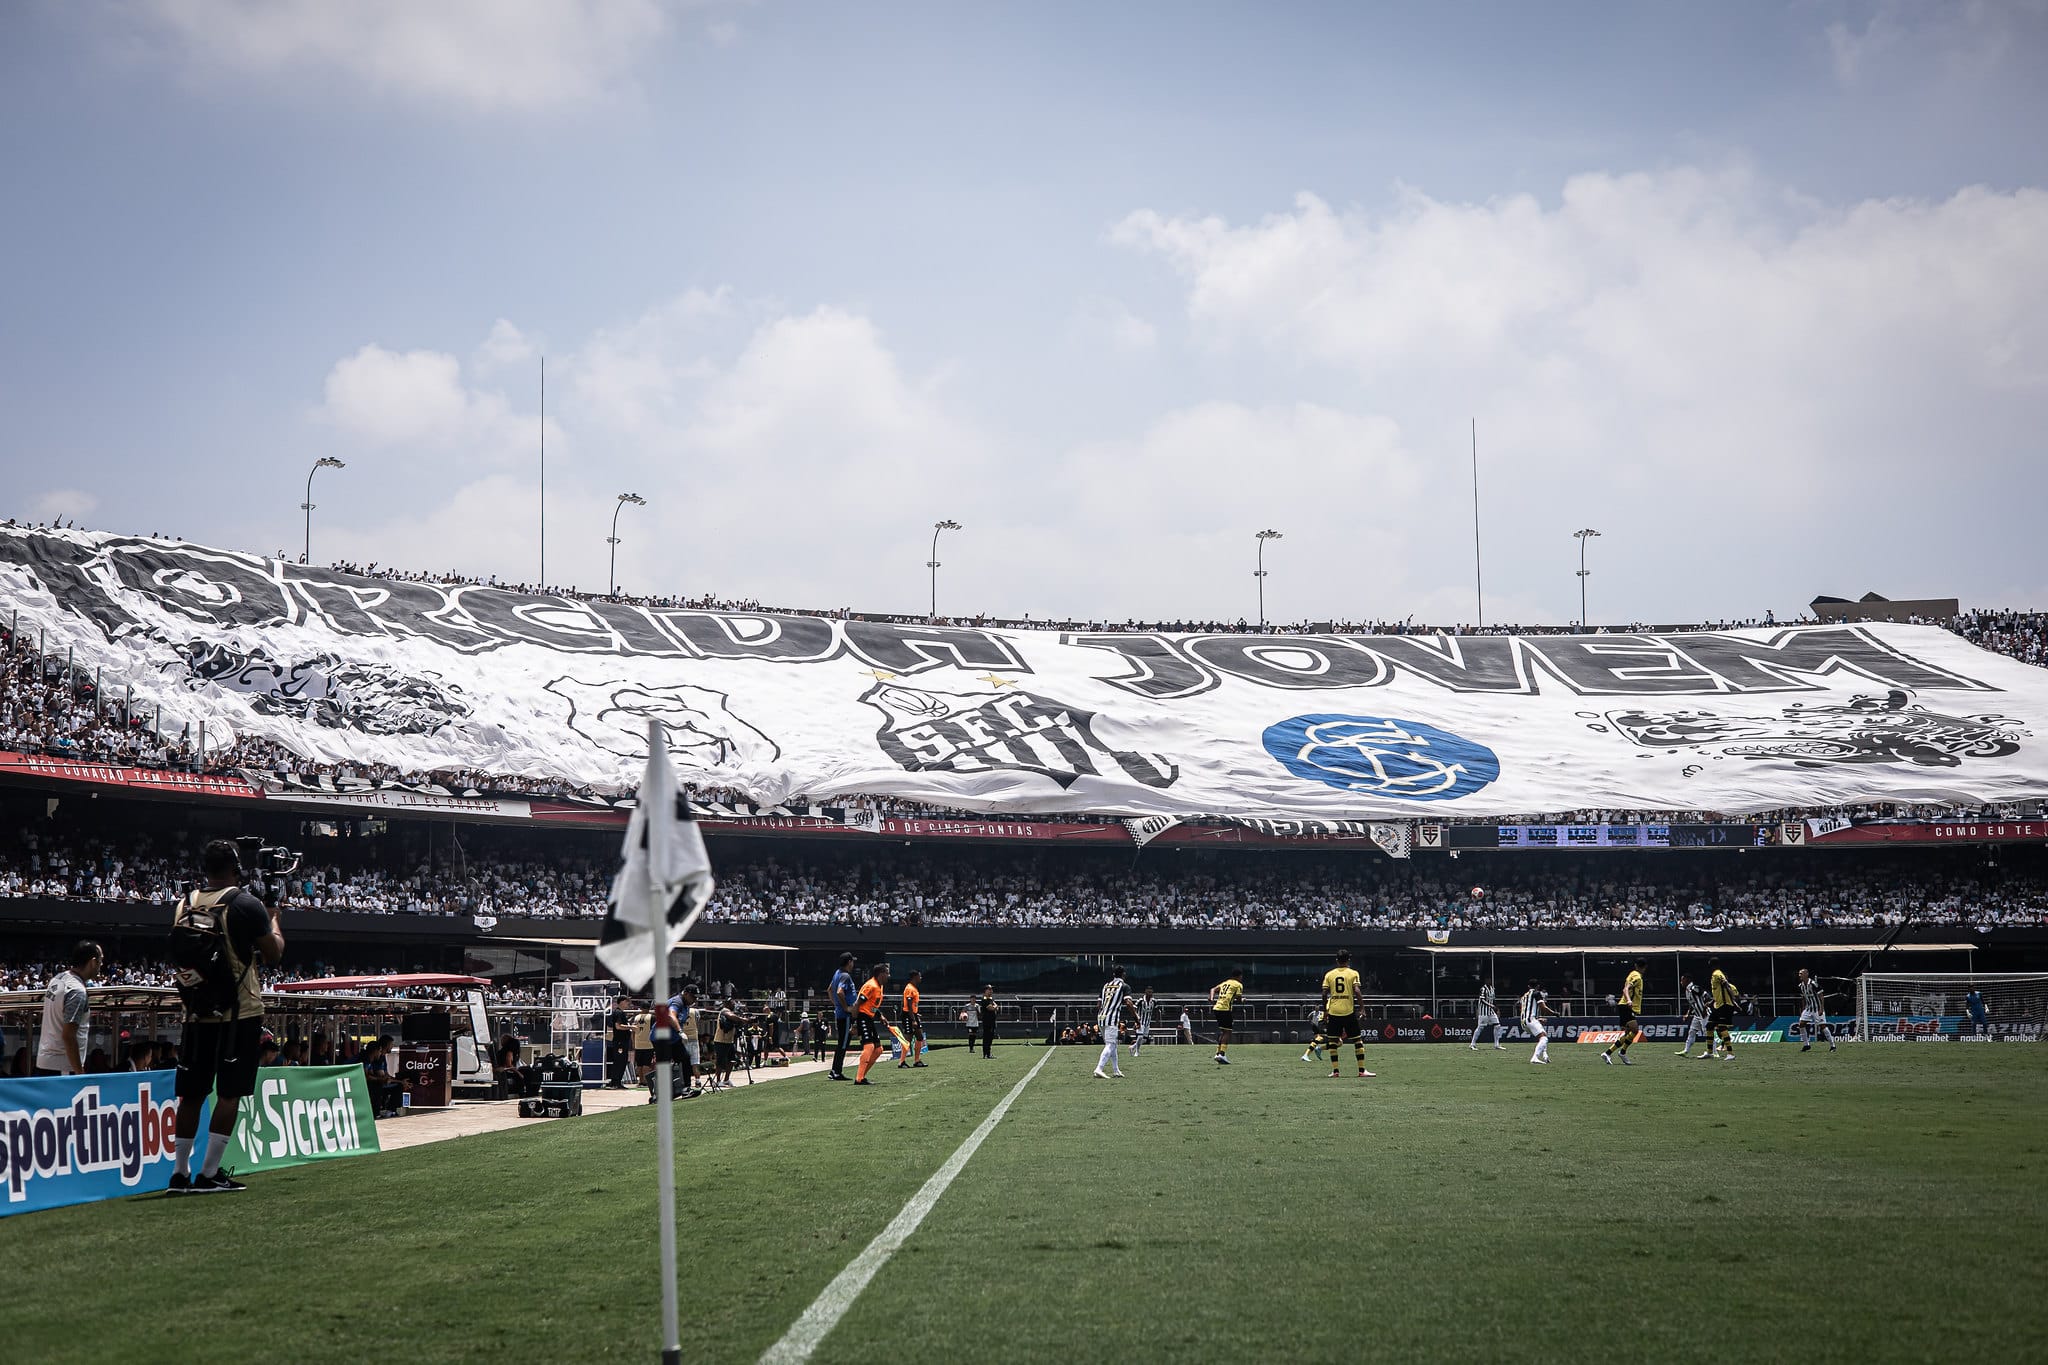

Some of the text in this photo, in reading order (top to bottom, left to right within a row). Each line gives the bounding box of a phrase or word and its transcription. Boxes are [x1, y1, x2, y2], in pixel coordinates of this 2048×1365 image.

[1058, 626, 2007, 699] JOVEM
[28, 758, 58, 775] MEU
[134, 771, 162, 786] TEM
[210, 779, 254, 795] CORES
[402, 792, 417, 805] TU
[448, 797, 502, 812] GRANDE
[904, 821, 921, 833] DE
[928, 823, 971, 835] CINCO
[979, 823, 1034, 837] PONTAS
[1935, 826, 1977, 837] COMO
[1987, 825, 2005, 836] EU
[2016, 825, 2032, 835] TE
[1335, 977, 1345, 993] 6
[1360, 1029, 1379, 1037] aze
[1397, 1027, 1426, 1037] blaze
[1444, 1027, 1473, 1037] blaze
[1872, 1033, 1906, 1042] novibet
[1916, 1033, 1949, 1042] novibet
[2003, 1033, 2037, 1042] novibet
[405, 1058, 436, 1070] Claro
[541, 1071, 554, 1081] TNT
[261, 1078, 361, 1159] Sicredi
[0, 1082, 179, 1202] portingbe
